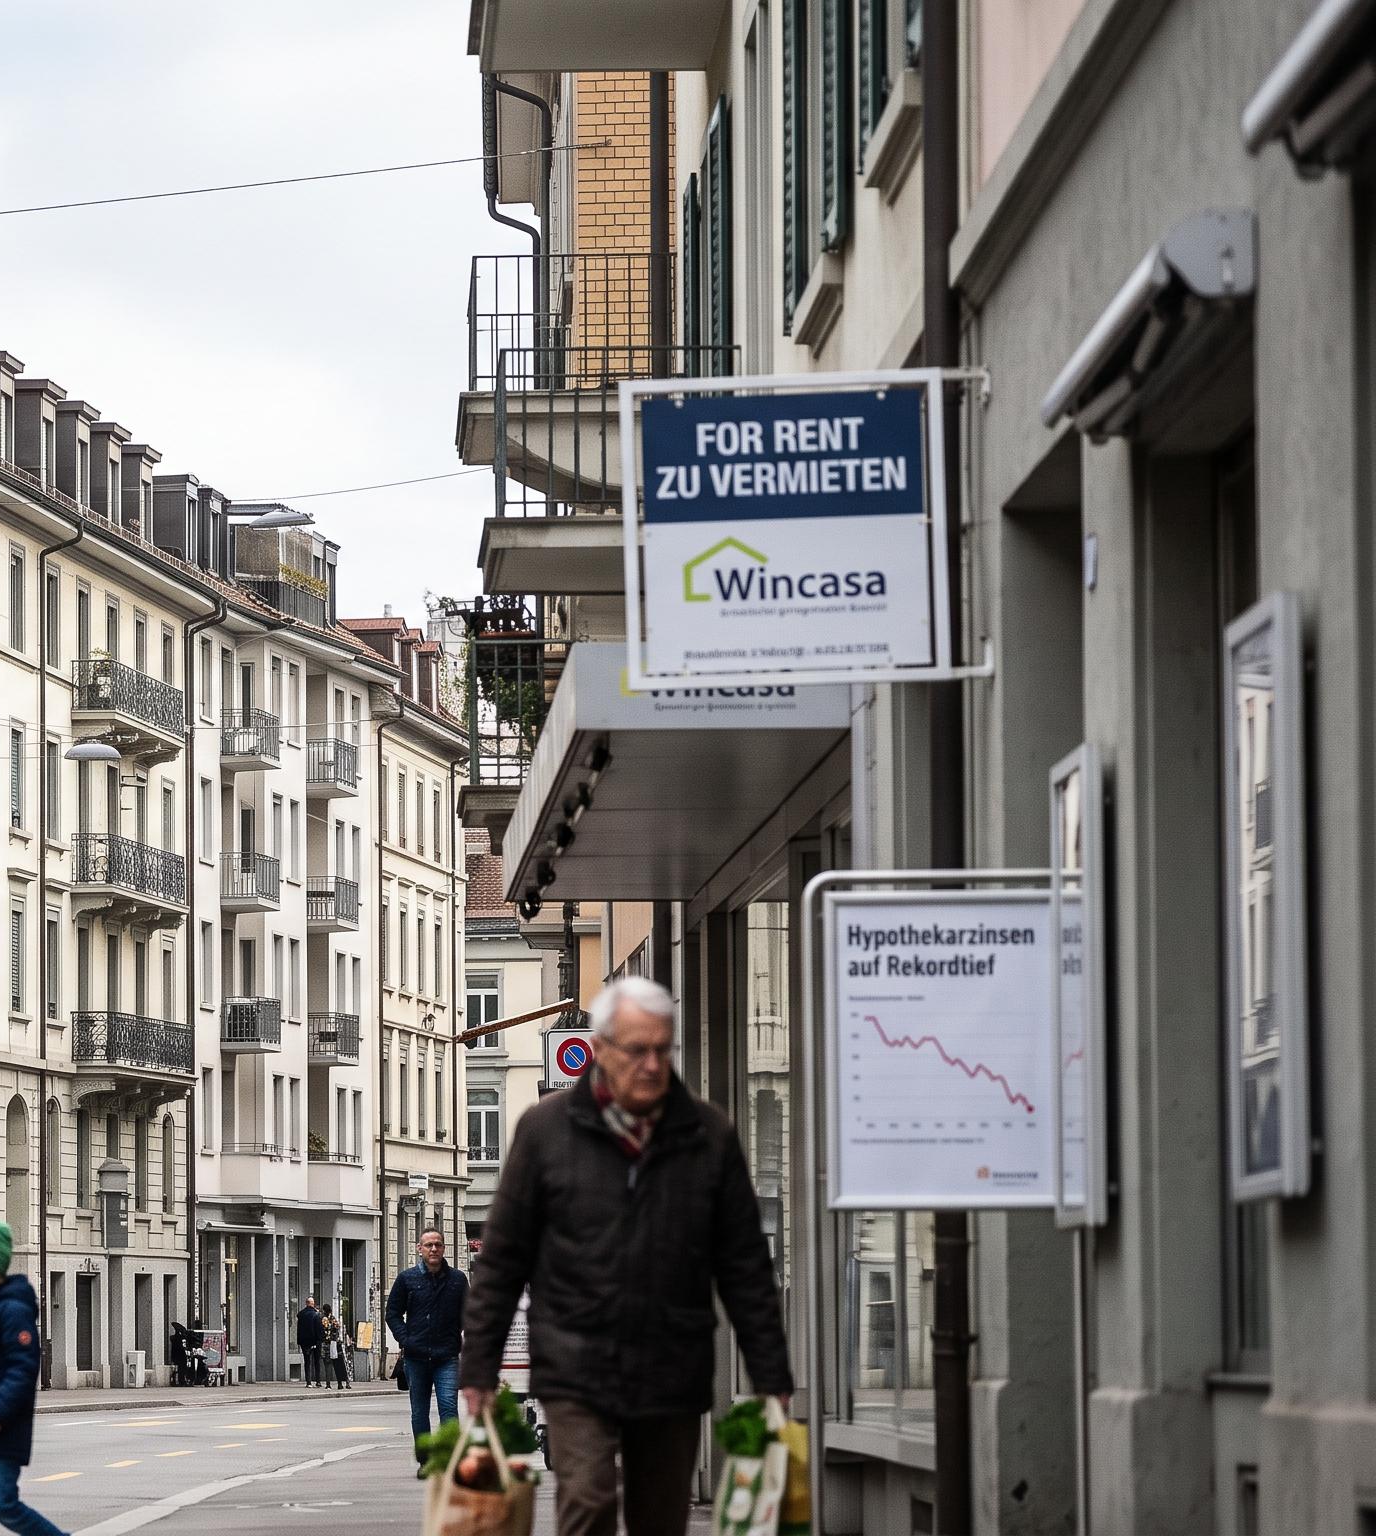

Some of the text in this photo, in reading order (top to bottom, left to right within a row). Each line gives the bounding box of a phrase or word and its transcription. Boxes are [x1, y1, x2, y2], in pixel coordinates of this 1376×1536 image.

[696, 416, 865, 456] FOR RENT
[655, 456, 907, 500] ZU VERMIETEN
[714, 566, 887, 601] Wincasa
[847, 924, 1036, 951] Hypothekarzinsen
[847, 953, 996, 978] auf Rekordtief
